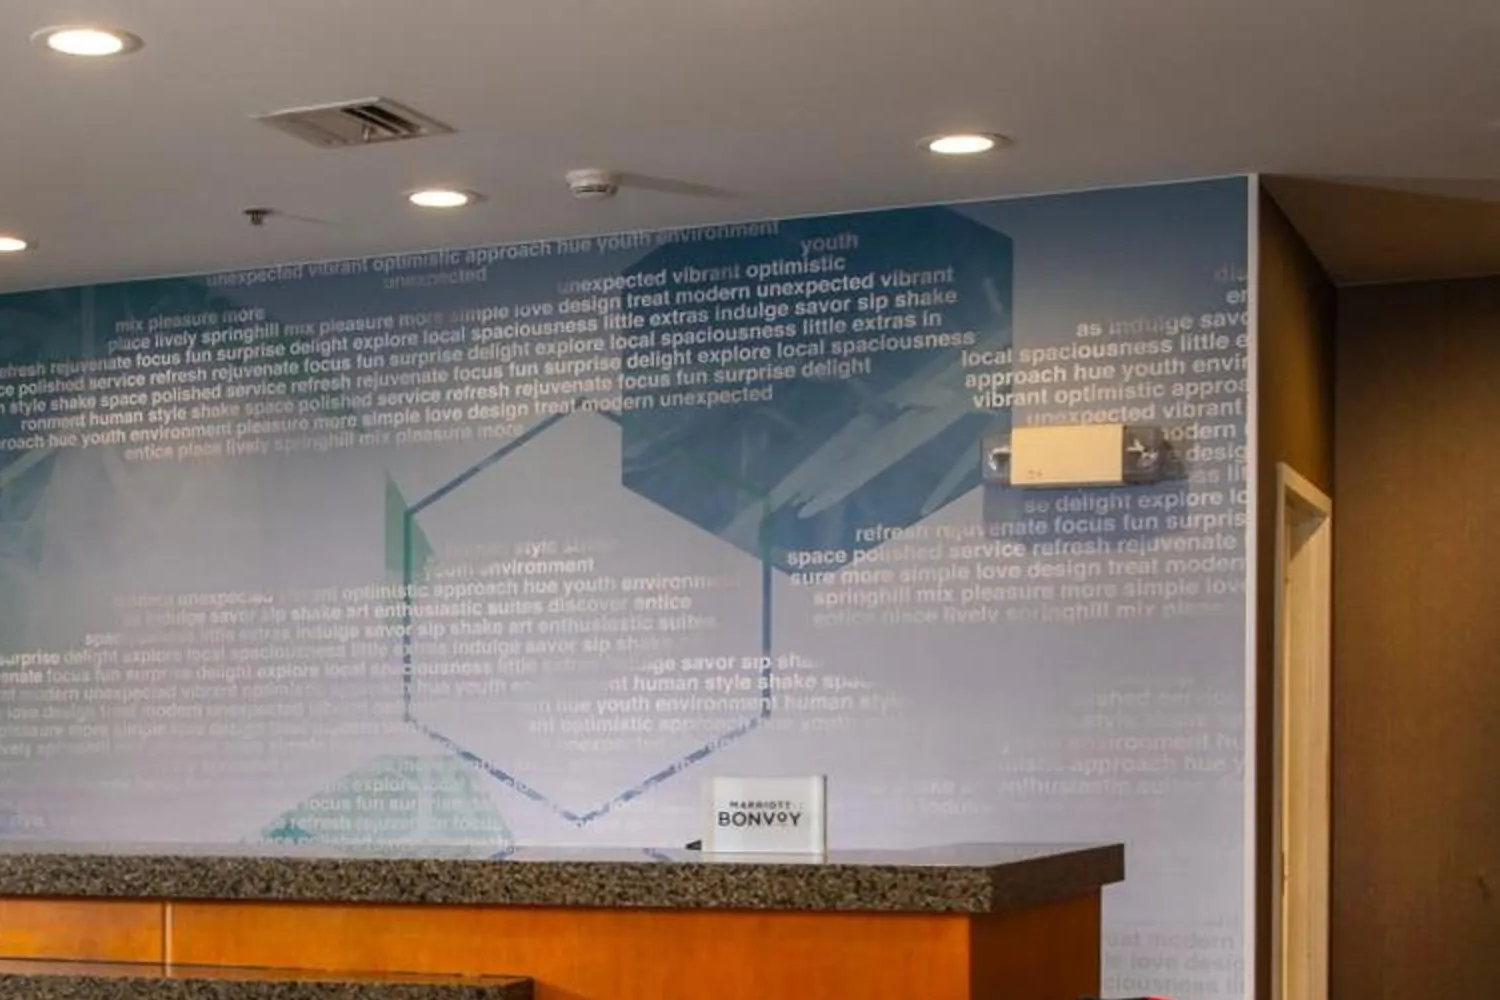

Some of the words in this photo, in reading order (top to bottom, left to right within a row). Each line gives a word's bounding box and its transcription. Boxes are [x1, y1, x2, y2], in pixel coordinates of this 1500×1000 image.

[746, 254, 846, 281] optimistic
[155, 328, 197, 348] lively
[202, 320, 279, 346] springhill
[320, 314, 393, 337] pleasure
[515, 300, 552, 317] love
[559, 293, 620, 314] design
[627, 288, 670, 308] treat
[676, 283, 751, 303] modern
[757, 270, 875, 297] unexpected
[881, 264, 954, 286] vibrant
[50, 354, 131, 376] rejuvenate
[136, 351, 180, 367] focus
[186, 347, 209, 363] fun
[216, 341, 285, 363] surprise
[290, 336, 347, 357] delight
[353, 332, 418, 353] explore
[424, 326, 466, 346] local
[471, 320, 597, 345] spaciousness
[604, 313, 644, 332] little
[650, 311, 708, 329] extras
[716, 303, 789, 325] indulge
[795, 300, 850, 318] savor
[858, 294, 888, 317] sip
[895, 289, 957, 311] shake
[19, 373, 85, 397] polished
[89, 370, 144, 388] service
[150, 364, 206, 384] refresh
[211, 359, 298, 382] rejuvenate
[304, 356, 351, 373] focus
[357, 352, 384, 369] fun
[389, 346, 462, 368] surprise
[468, 340, 529, 362] delight
[535, 336, 605, 358] explore
[610, 330, 655, 350] local
[661, 323, 796, 350] spaciousness
[803, 316, 846, 336] little
[852, 313, 916, 332] extras
[922, 309, 942, 327] in
[962, 349, 1013, 367] local
[1019, 339, 1173, 364] spaciousness
[1180, 334, 1228, 352] little
[10, 396, 45, 416] style
[50, 392, 95, 410] shake
[100, 391, 147, 410] space
[152, 382, 221, 407] polished
[225, 379, 286, 398] service
[291, 373, 350, 393] refresh
[357, 367, 448, 391] rejuvenate
[453, 365, 502, 381] focus
[509, 360, 538, 377] fun
[544, 354, 621, 377] surprise
[627, 348, 692, 371] delight
[697, 344, 771, 367] explore
[777, 337, 824, 358] local
[831, 330, 976, 358] spaciousness
[965, 365, 1068, 389] approach
[1074, 362, 1114, 380] hue
[1121, 358, 1185, 381] youth
[90, 410, 141, 425] human
[148, 404, 186, 424] style
[299, 390, 372, 415] polished
[378, 386, 439, 405] service
[445, 380, 509, 401] refresh
[515, 374, 613, 399] rejuvenate
[618, 371, 671, 389] focus
[677, 367, 707, 385] fun
[713, 361, 796, 384] surprise
[802, 354, 871, 378] delight
[972, 389, 1048, 408] vibrant
[1054, 381, 1164, 406] optimistic
[82, 426, 125, 448] youth
[314, 414, 357, 429] more
[362, 407, 420, 428] simple
[425, 405, 462, 422] love
[468, 400, 528, 421] design
[535, 397, 576, 415] treat
[582, 392, 654, 411] modern
[660, 382, 773, 408] unexpected
[1162, 398, 1242, 418] vibrant
[1054, 489, 1131, 516] delight
[1137, 487, 1223, 511] explore
[1053, 516, 1116, 535] focus
[1123, 514, 1158, 532] fun
[787, 548, 847, 569] space
[948, 543, 1023, 561] service
[1030, 538, 1108, 558] refresh
[833, 569, 888, 584] more
[970, 562, 1014, 580] love
[1021, 558, 1095, 582] design
[1102, 557, 1153, 575] treat
[523, 578, 558, 595] hue
[563, 576, 615, 598] youth
[633, 674, 698, 690] human
[704, 673, 751, 694] style
[597, 696, 649, 717] youth
[717, 811, 802, 827] BONVOY
